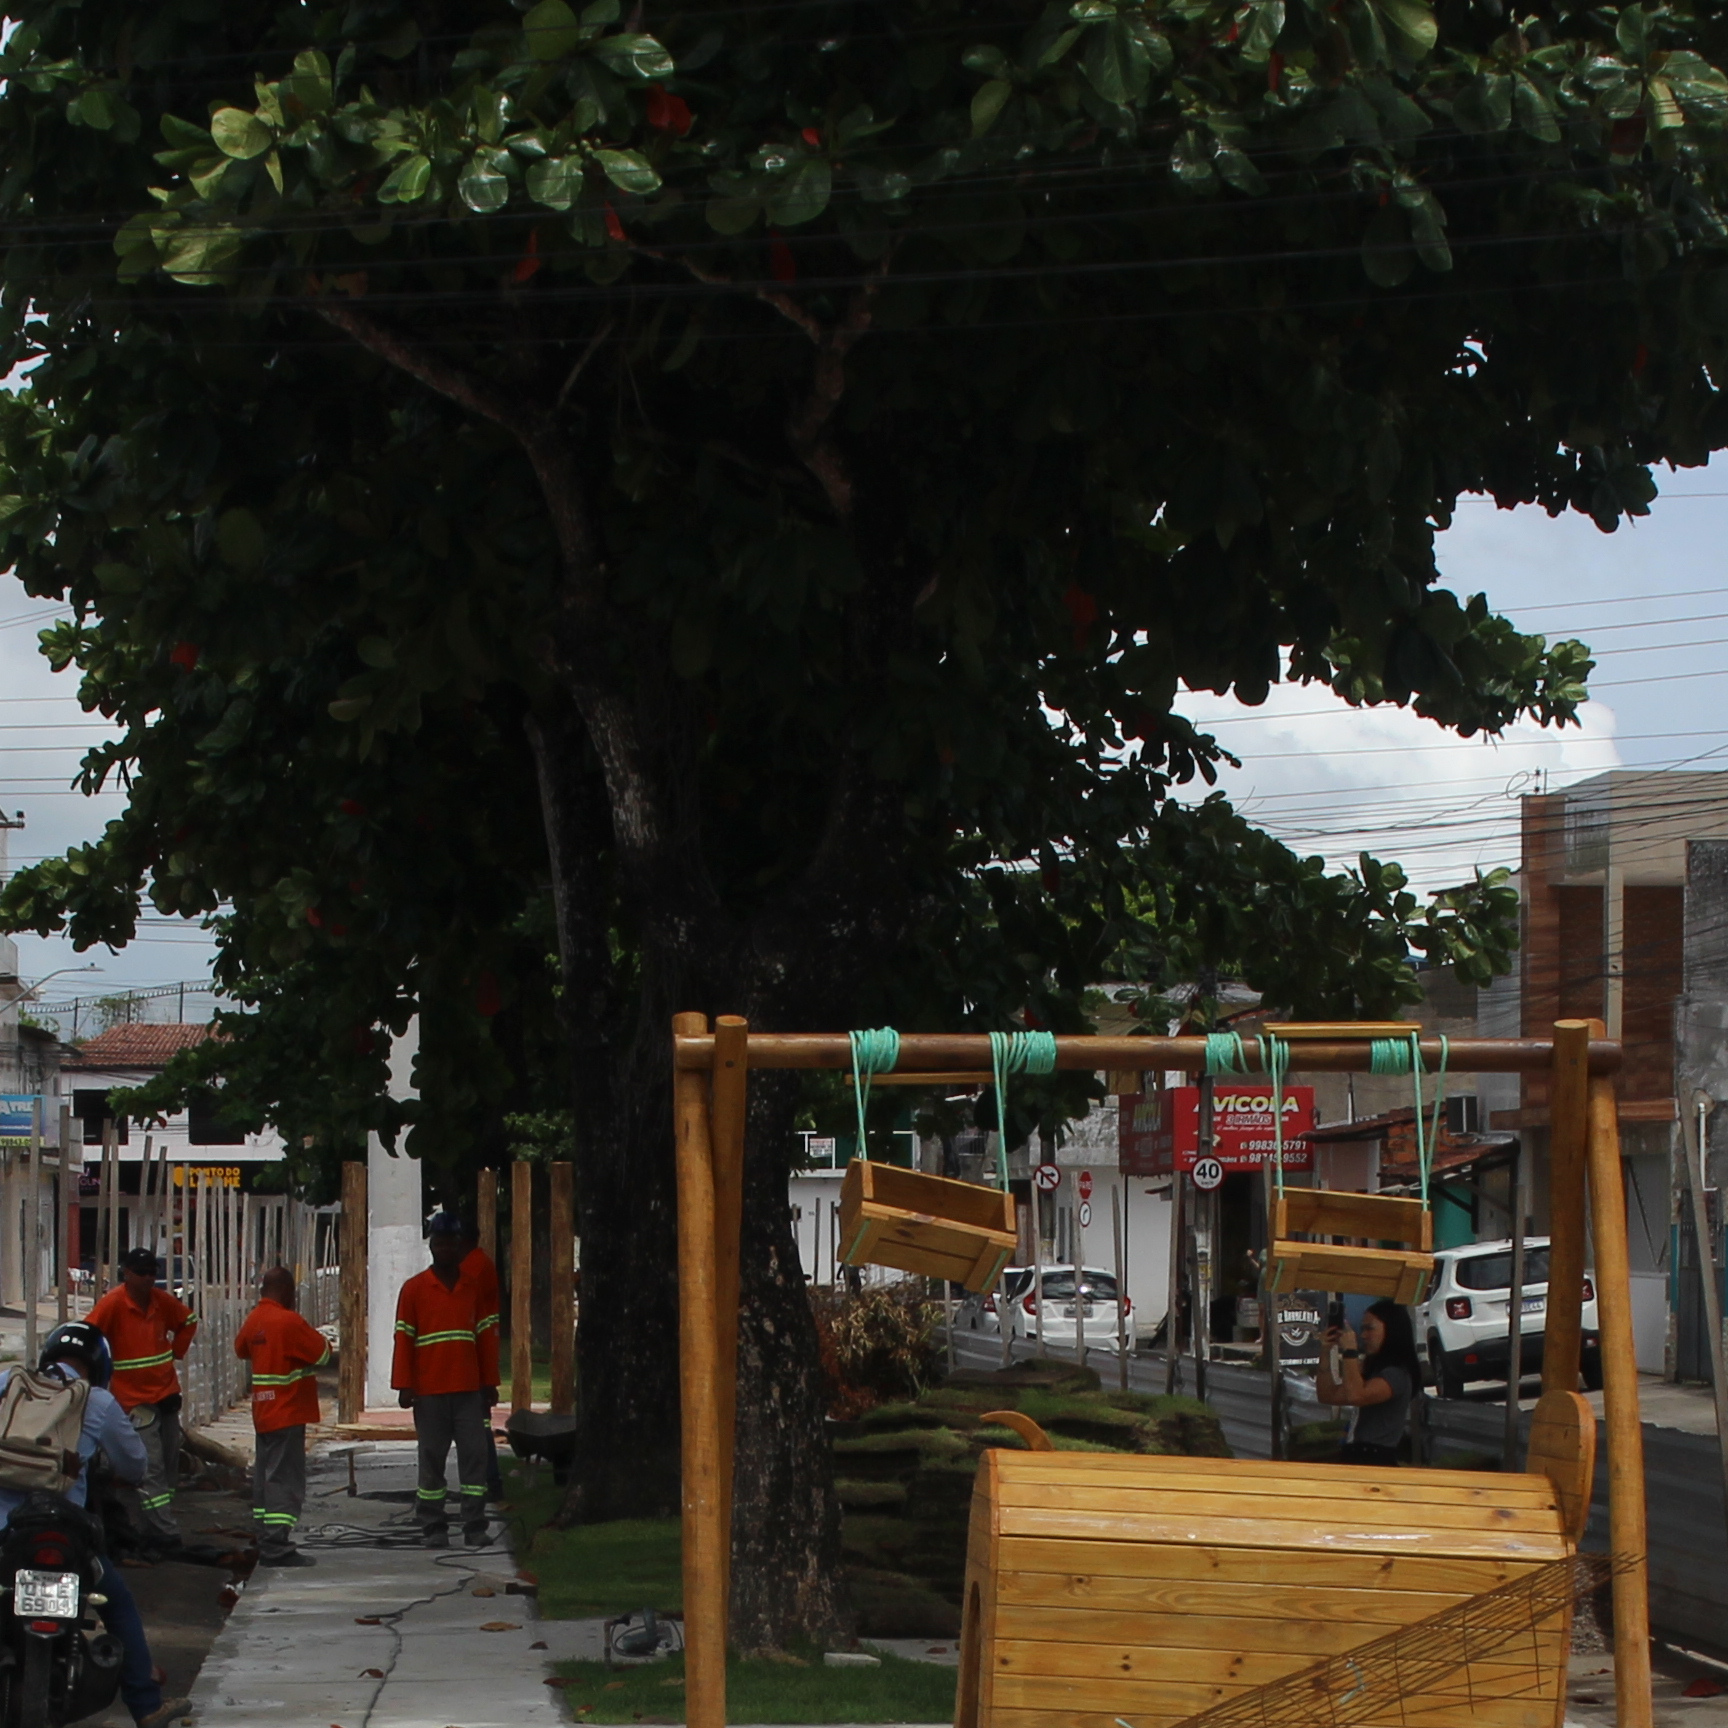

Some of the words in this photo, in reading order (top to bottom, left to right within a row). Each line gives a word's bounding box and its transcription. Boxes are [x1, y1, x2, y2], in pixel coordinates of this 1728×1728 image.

[1193, 1094, 1299, 1113] VÍCOLA
[1196, 1163, 1220, 1179] 40
[22, 1597, 70, 1614] 6904
